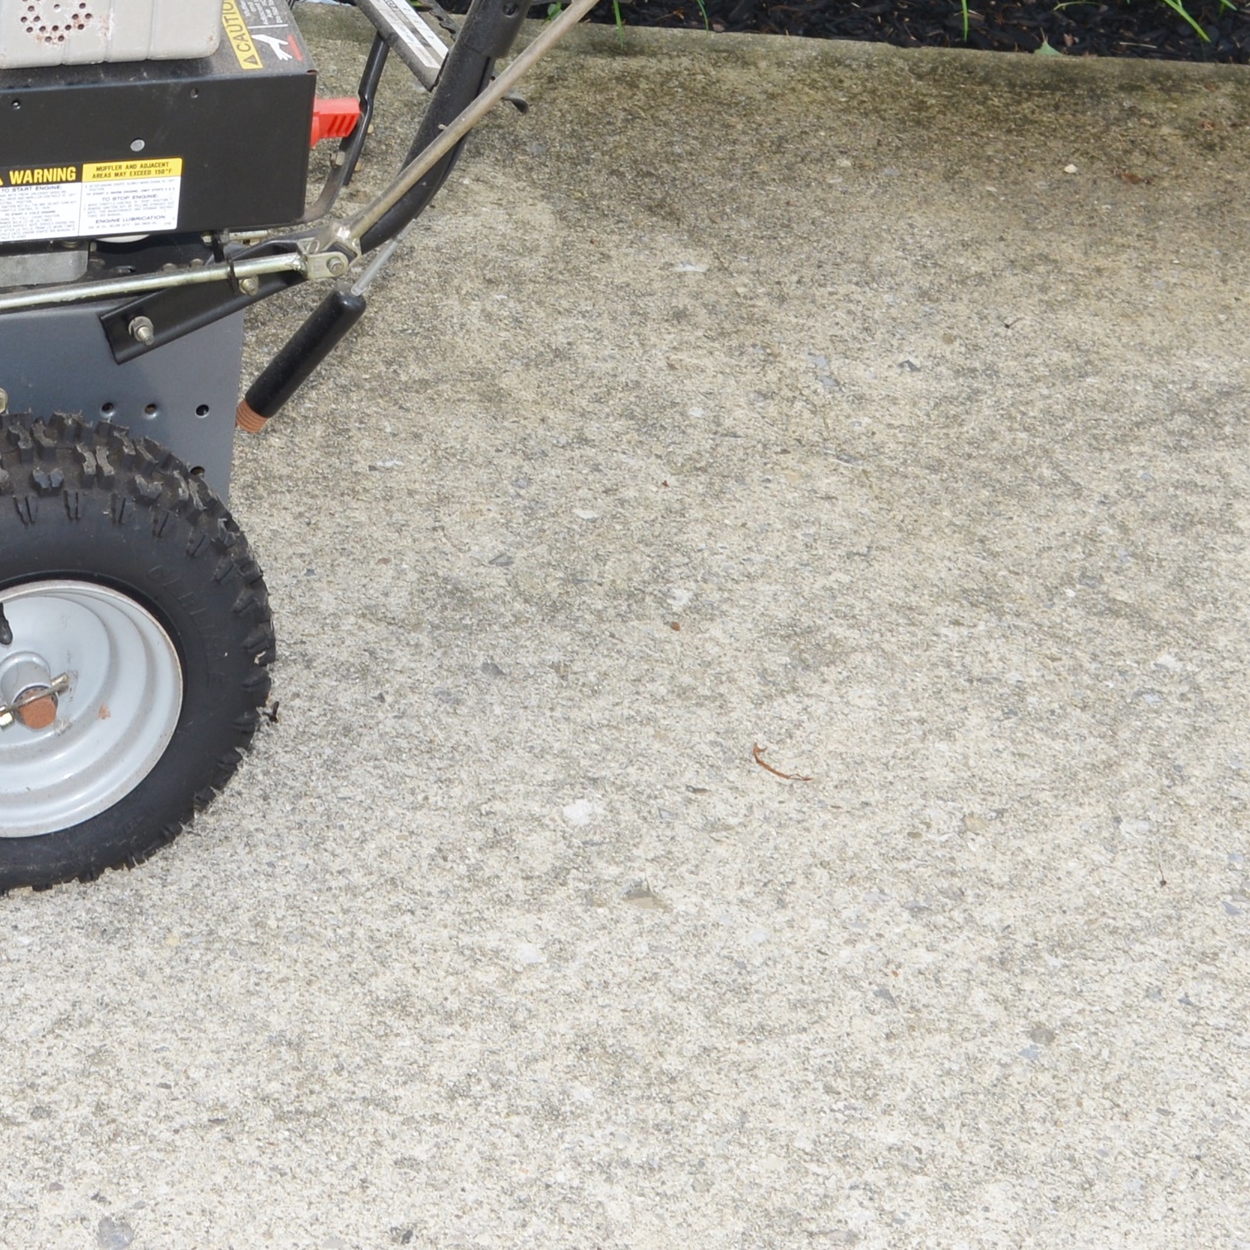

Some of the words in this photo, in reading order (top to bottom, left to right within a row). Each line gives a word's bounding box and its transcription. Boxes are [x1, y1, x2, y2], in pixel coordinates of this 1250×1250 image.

[95, 164, 123, 172] MUFFLER
[140, 161, 170, 169] ADJACENT
[9, 166, 77, 185] WARNING
[92, 171, 112, 179] AREAS
[114, 170, 126, 178] MAY
[129, 168, 152, 177] EXCEED
